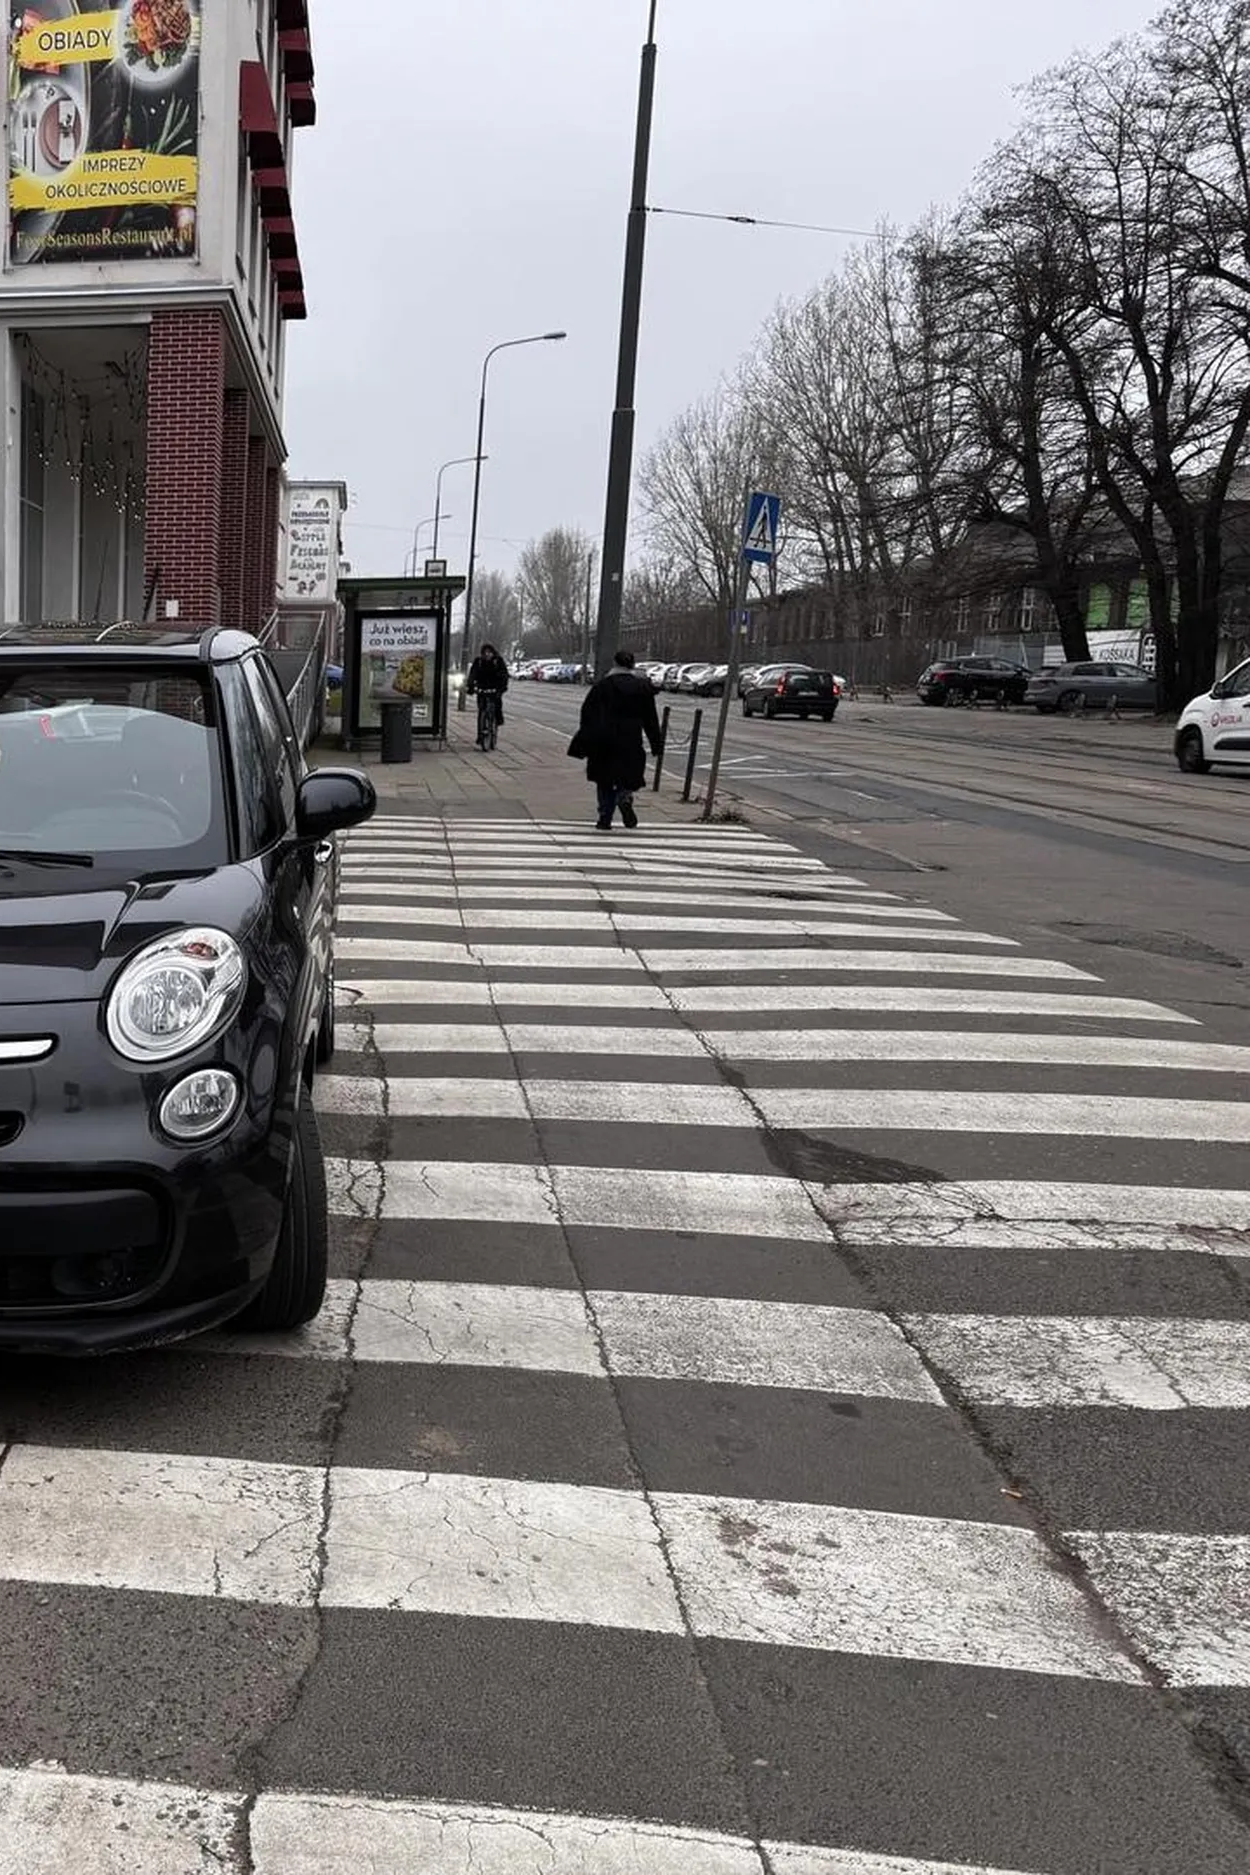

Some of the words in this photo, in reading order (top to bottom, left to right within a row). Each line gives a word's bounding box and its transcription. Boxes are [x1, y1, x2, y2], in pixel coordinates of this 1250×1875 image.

[38, 29, 112, 51] OBIADY
[82, 156, 147, 173] IMPREZY
[45, 178, 188, 199] OKOLICZNOŚCIOWE
